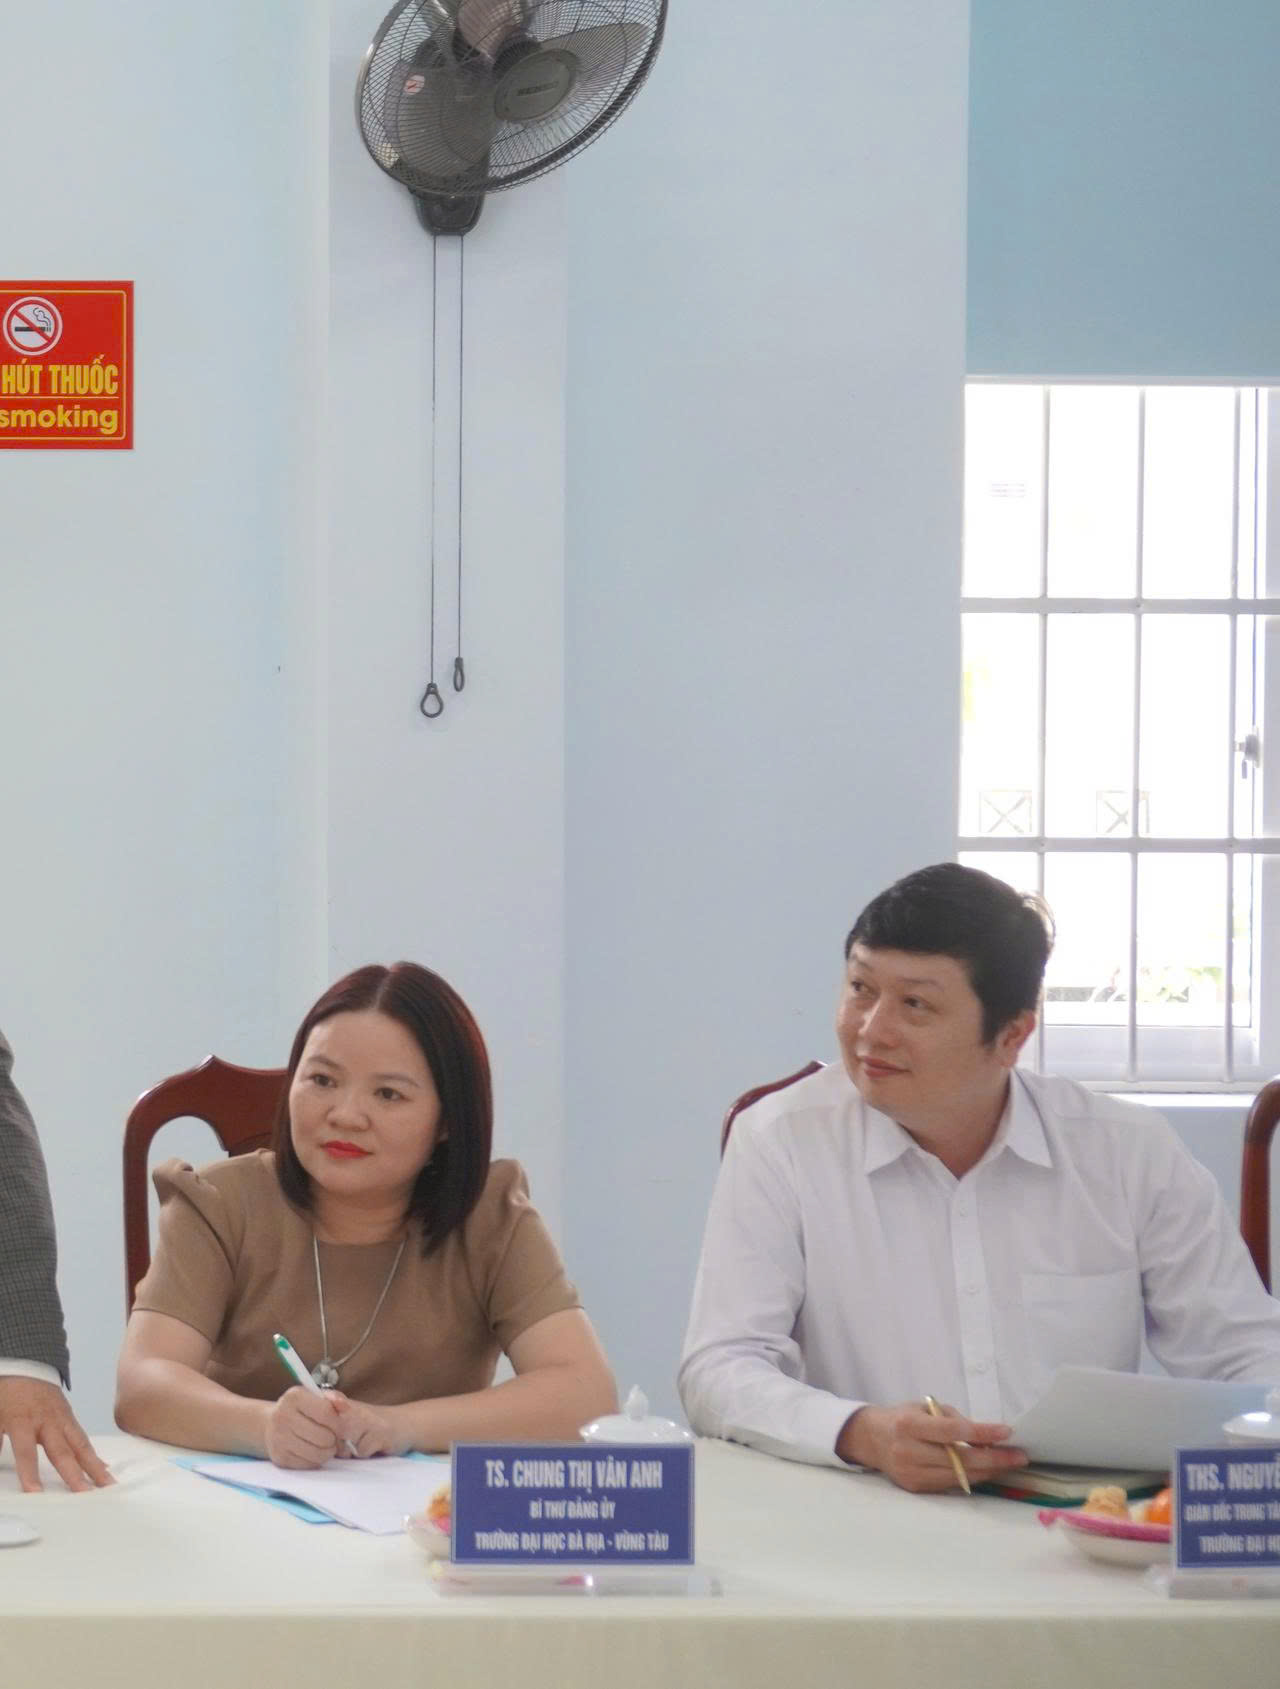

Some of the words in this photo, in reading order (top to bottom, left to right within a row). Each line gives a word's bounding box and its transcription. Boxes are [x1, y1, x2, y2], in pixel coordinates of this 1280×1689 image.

[2, 358, 43, 394] HÚT
[48, 354, 118, 394] THUỐC
[485, 1460, 509, 1488] TS.
[512, 1460, 565, 1488] CHUNG
[568, 1460, 592, 1494] THỊ
[595, 1455, 627, 1489] VÂN
[630, 1460, 663, 1489] ANH
[530, 1498, 542, 1518] BÍ
[544, 1501, 566, 1519] THƯ
[567, 1496, 598, 1519] ĐẢNG
[521, 1532, 540, 1554] ĐẠI
[543, 1532, 566, 1554] HỌC
[567, 1530, 584, 1551] BÀ
[585, 1532, 605, 1554] RỊA
[647, 1530, 669, 1551] TÀU
